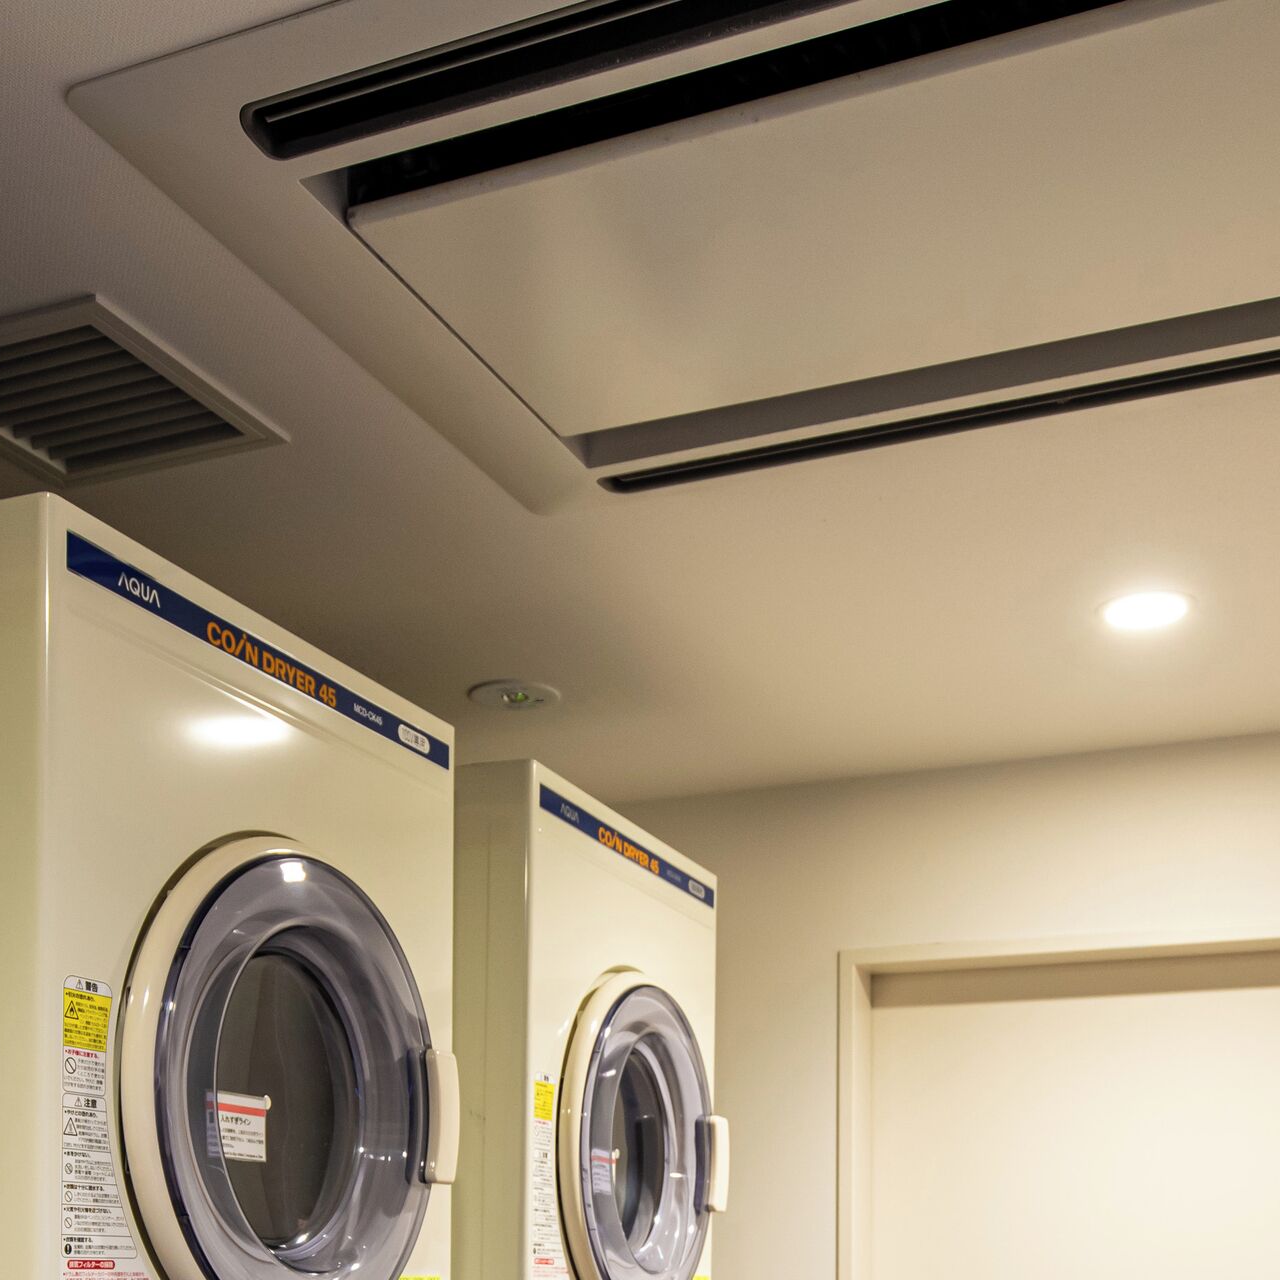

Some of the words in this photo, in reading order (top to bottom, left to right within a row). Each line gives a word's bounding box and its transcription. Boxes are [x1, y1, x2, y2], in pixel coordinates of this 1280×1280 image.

[118, 572, 160, 608] AQUA
[263, 652, 315, 694] DRYER
[319, 683, 336, 707] 45
[624, 842, 648, 867] DRYER
[650, 859, 659, 874] 45
